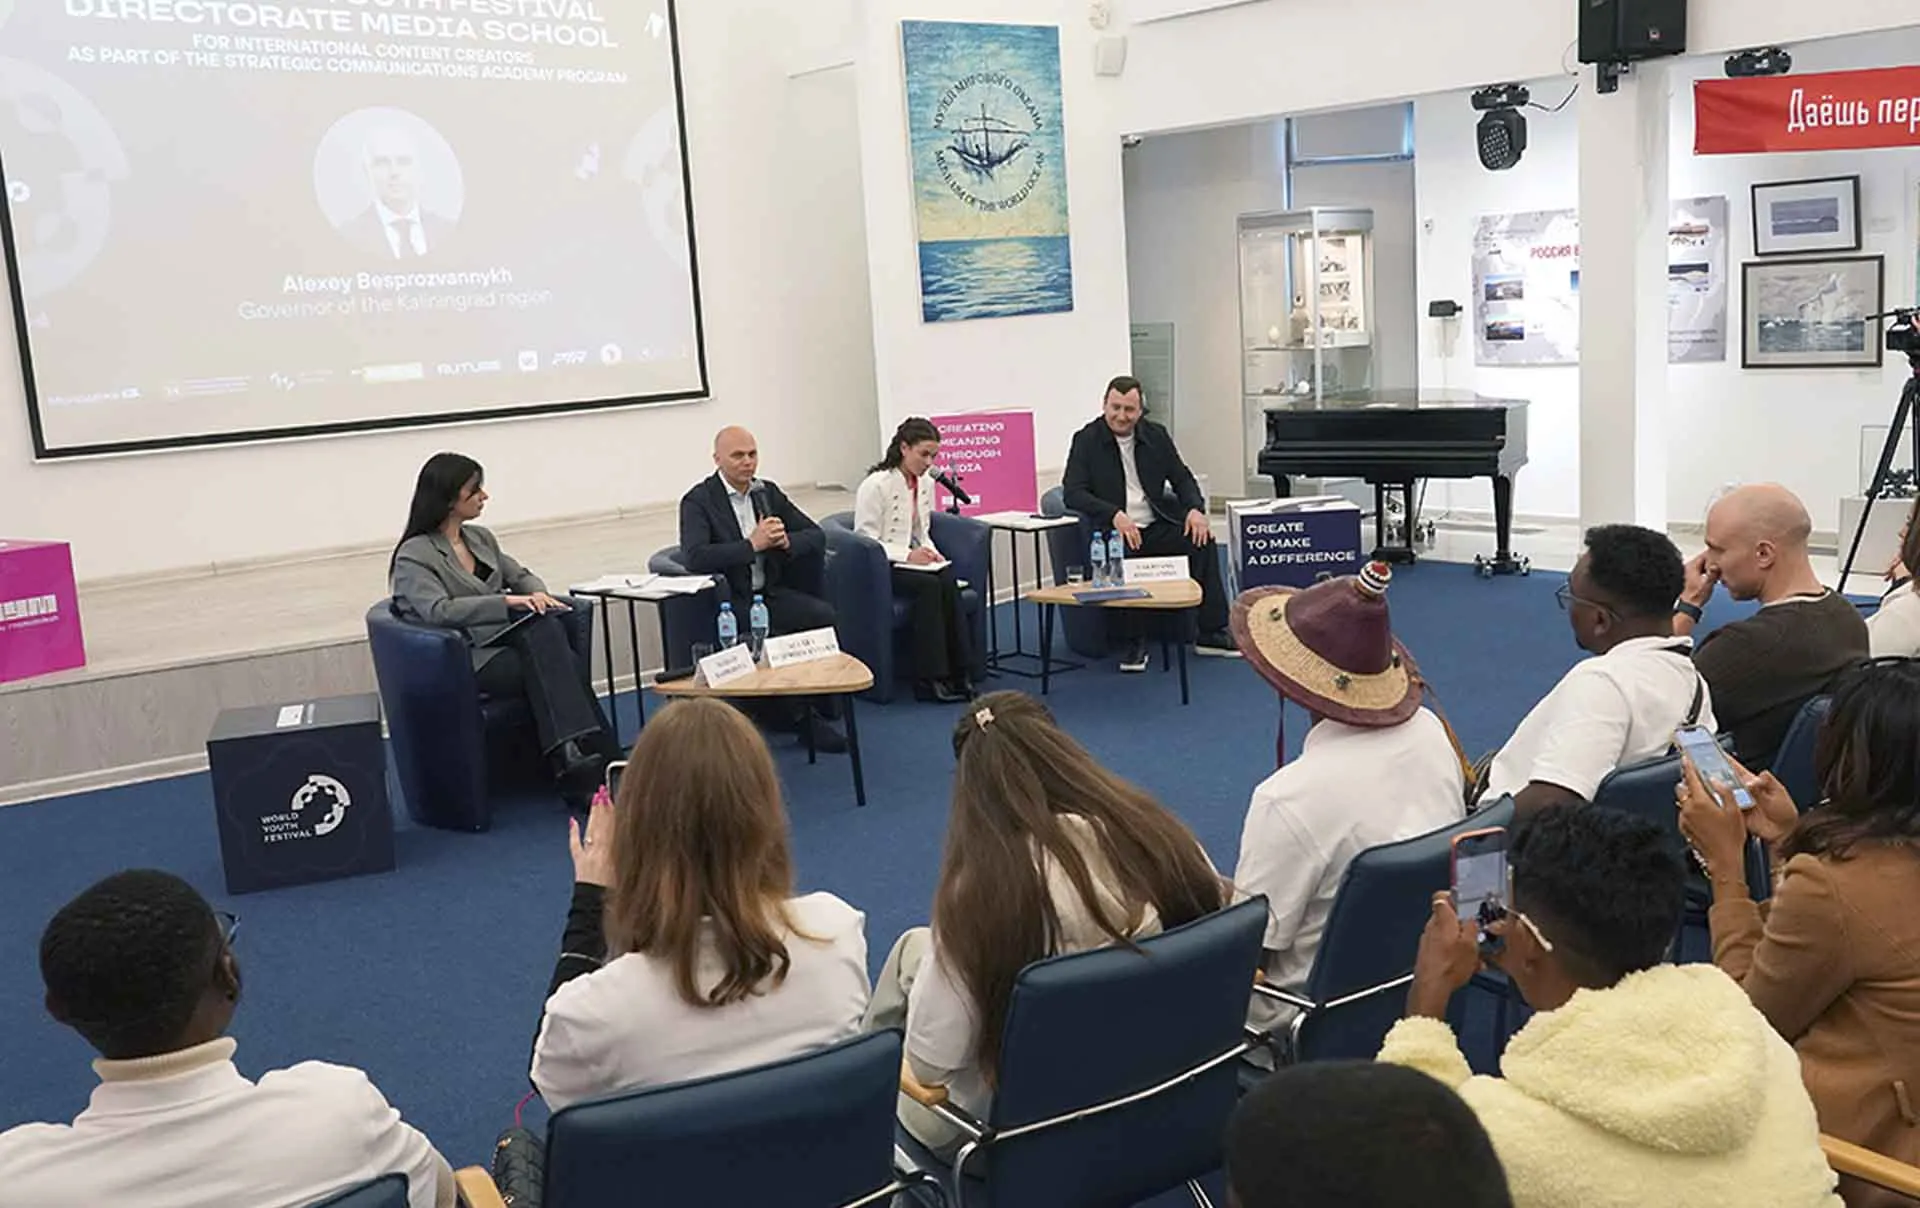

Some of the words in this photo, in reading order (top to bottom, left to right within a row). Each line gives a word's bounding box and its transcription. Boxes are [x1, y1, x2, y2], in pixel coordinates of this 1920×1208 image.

[65, 0, 355, 32] DIRECTORATE
[361, 12, 478, 40] MEDIA
[483, 20, 619, 48] SCHOOL
[192, 33, 230, 50] FOR
[234, 36, 372, 57] INTERNATIONAL
[375, 43, 452, 61] CONTENT
[454, 47, 535, 65] CREATORS
[67, 46, 96, 64] AS
[100, 47, 151, 66] PART
[154, 49, 182, 67] OF
[184, 51, 221, 68] THE
[225, 52, 322, 72] STRATEGIC
[326, 57, 478, 79] COMMUNICATIONS
[482, 65, 553, 82] ACADEMY
[557, 70, 628, 83] PROGRAM
[1787, 88, 1870, 133] Даёшь
[1878, 97, 1920, 134] пер
[1530, 245, 1571, 259] РОССИЯ
[283, 274, 352, 295] Alexey
[357, 266, 514, 292] Besprozvannykh
[238, 296, 333, 321] Governor
[338, 297, 356, 315] of
[361, 294, 393, 313] the
[397, 290, 495, 313] Kaliningrad
[499, 288, 553, 311] region
[938, 422, 1005, 434] CREATING
[939, 435, 1001, 447] MEANING
[939, 449, 1002, 460] THROUGH
[1246, 521, 1305, 535] CREATE
[1247, 539, 1267, 550] TO
[1269, 537, 1312, 549] MAKE
[1247, 555, 1259, 566] A
[1260, 551, 1356, 565] DIFFERENCE
[260, 812, 299, 824] WORLD
[261, 822, 299, 833] YOUTH
[263, 829, 312, 843] FESTIVAL
